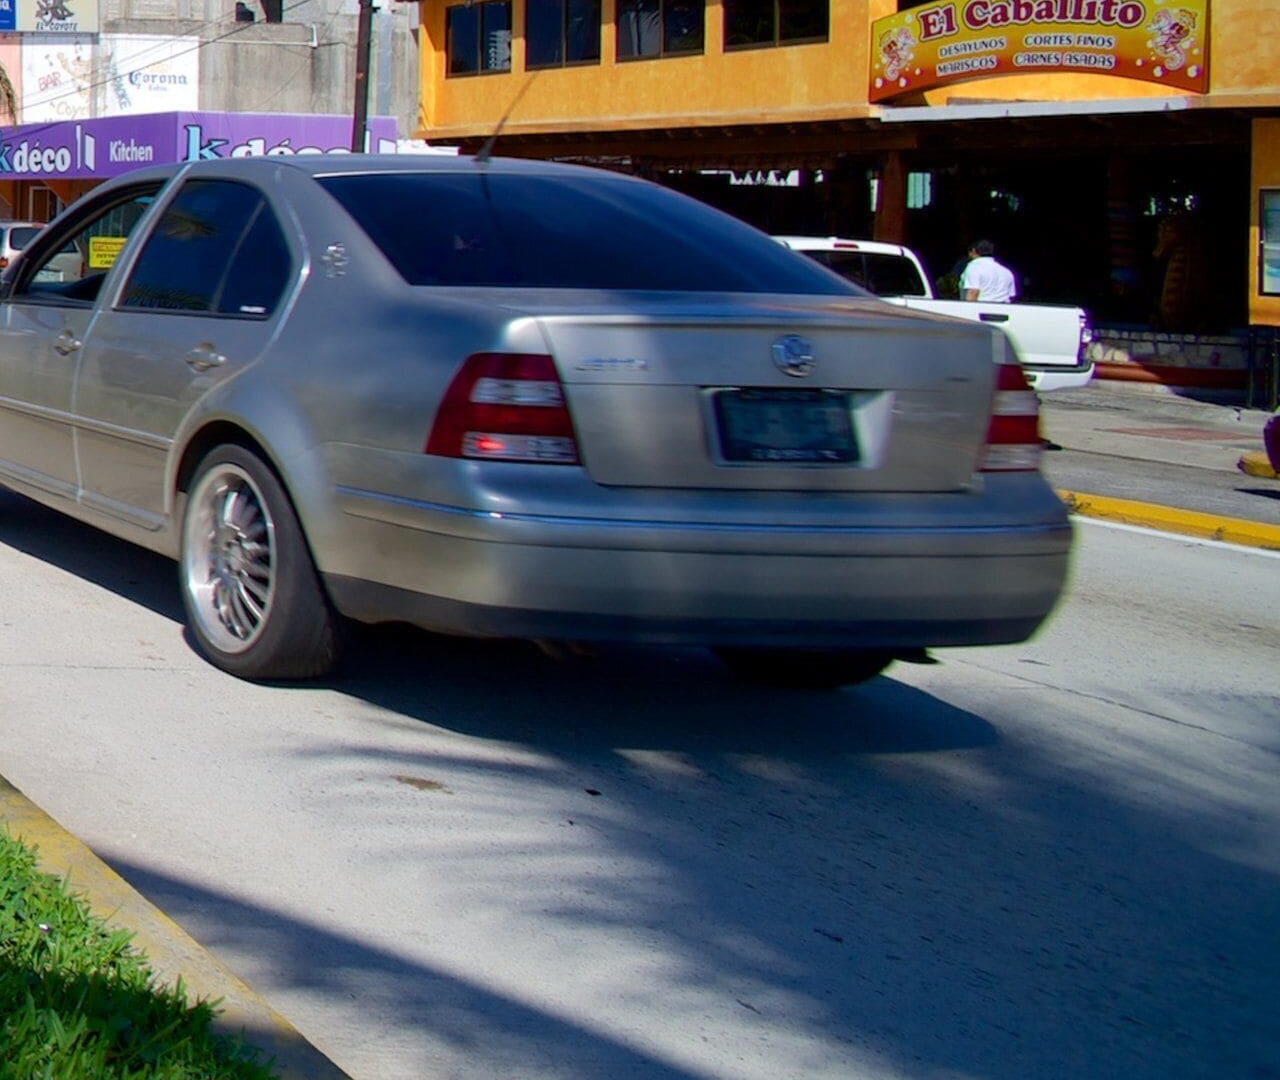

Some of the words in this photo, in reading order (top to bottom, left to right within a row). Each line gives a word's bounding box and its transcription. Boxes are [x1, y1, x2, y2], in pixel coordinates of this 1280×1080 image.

[918, 4, 958, 41] El
[939, 35, 1007, 58] DESAYUNOS
[1024, 34, 1073, 48] CORTES
[1076, 34, 1116, 49] FINOS
[936, 55, 997, 76] MARISCOS
[1014, 52, 1061, 67] CARNES
[1063, 53, 1116, 68] ASADAS
[128, 71, 188, 89] Corona
[109, 141, 153, 162] Kitchen
